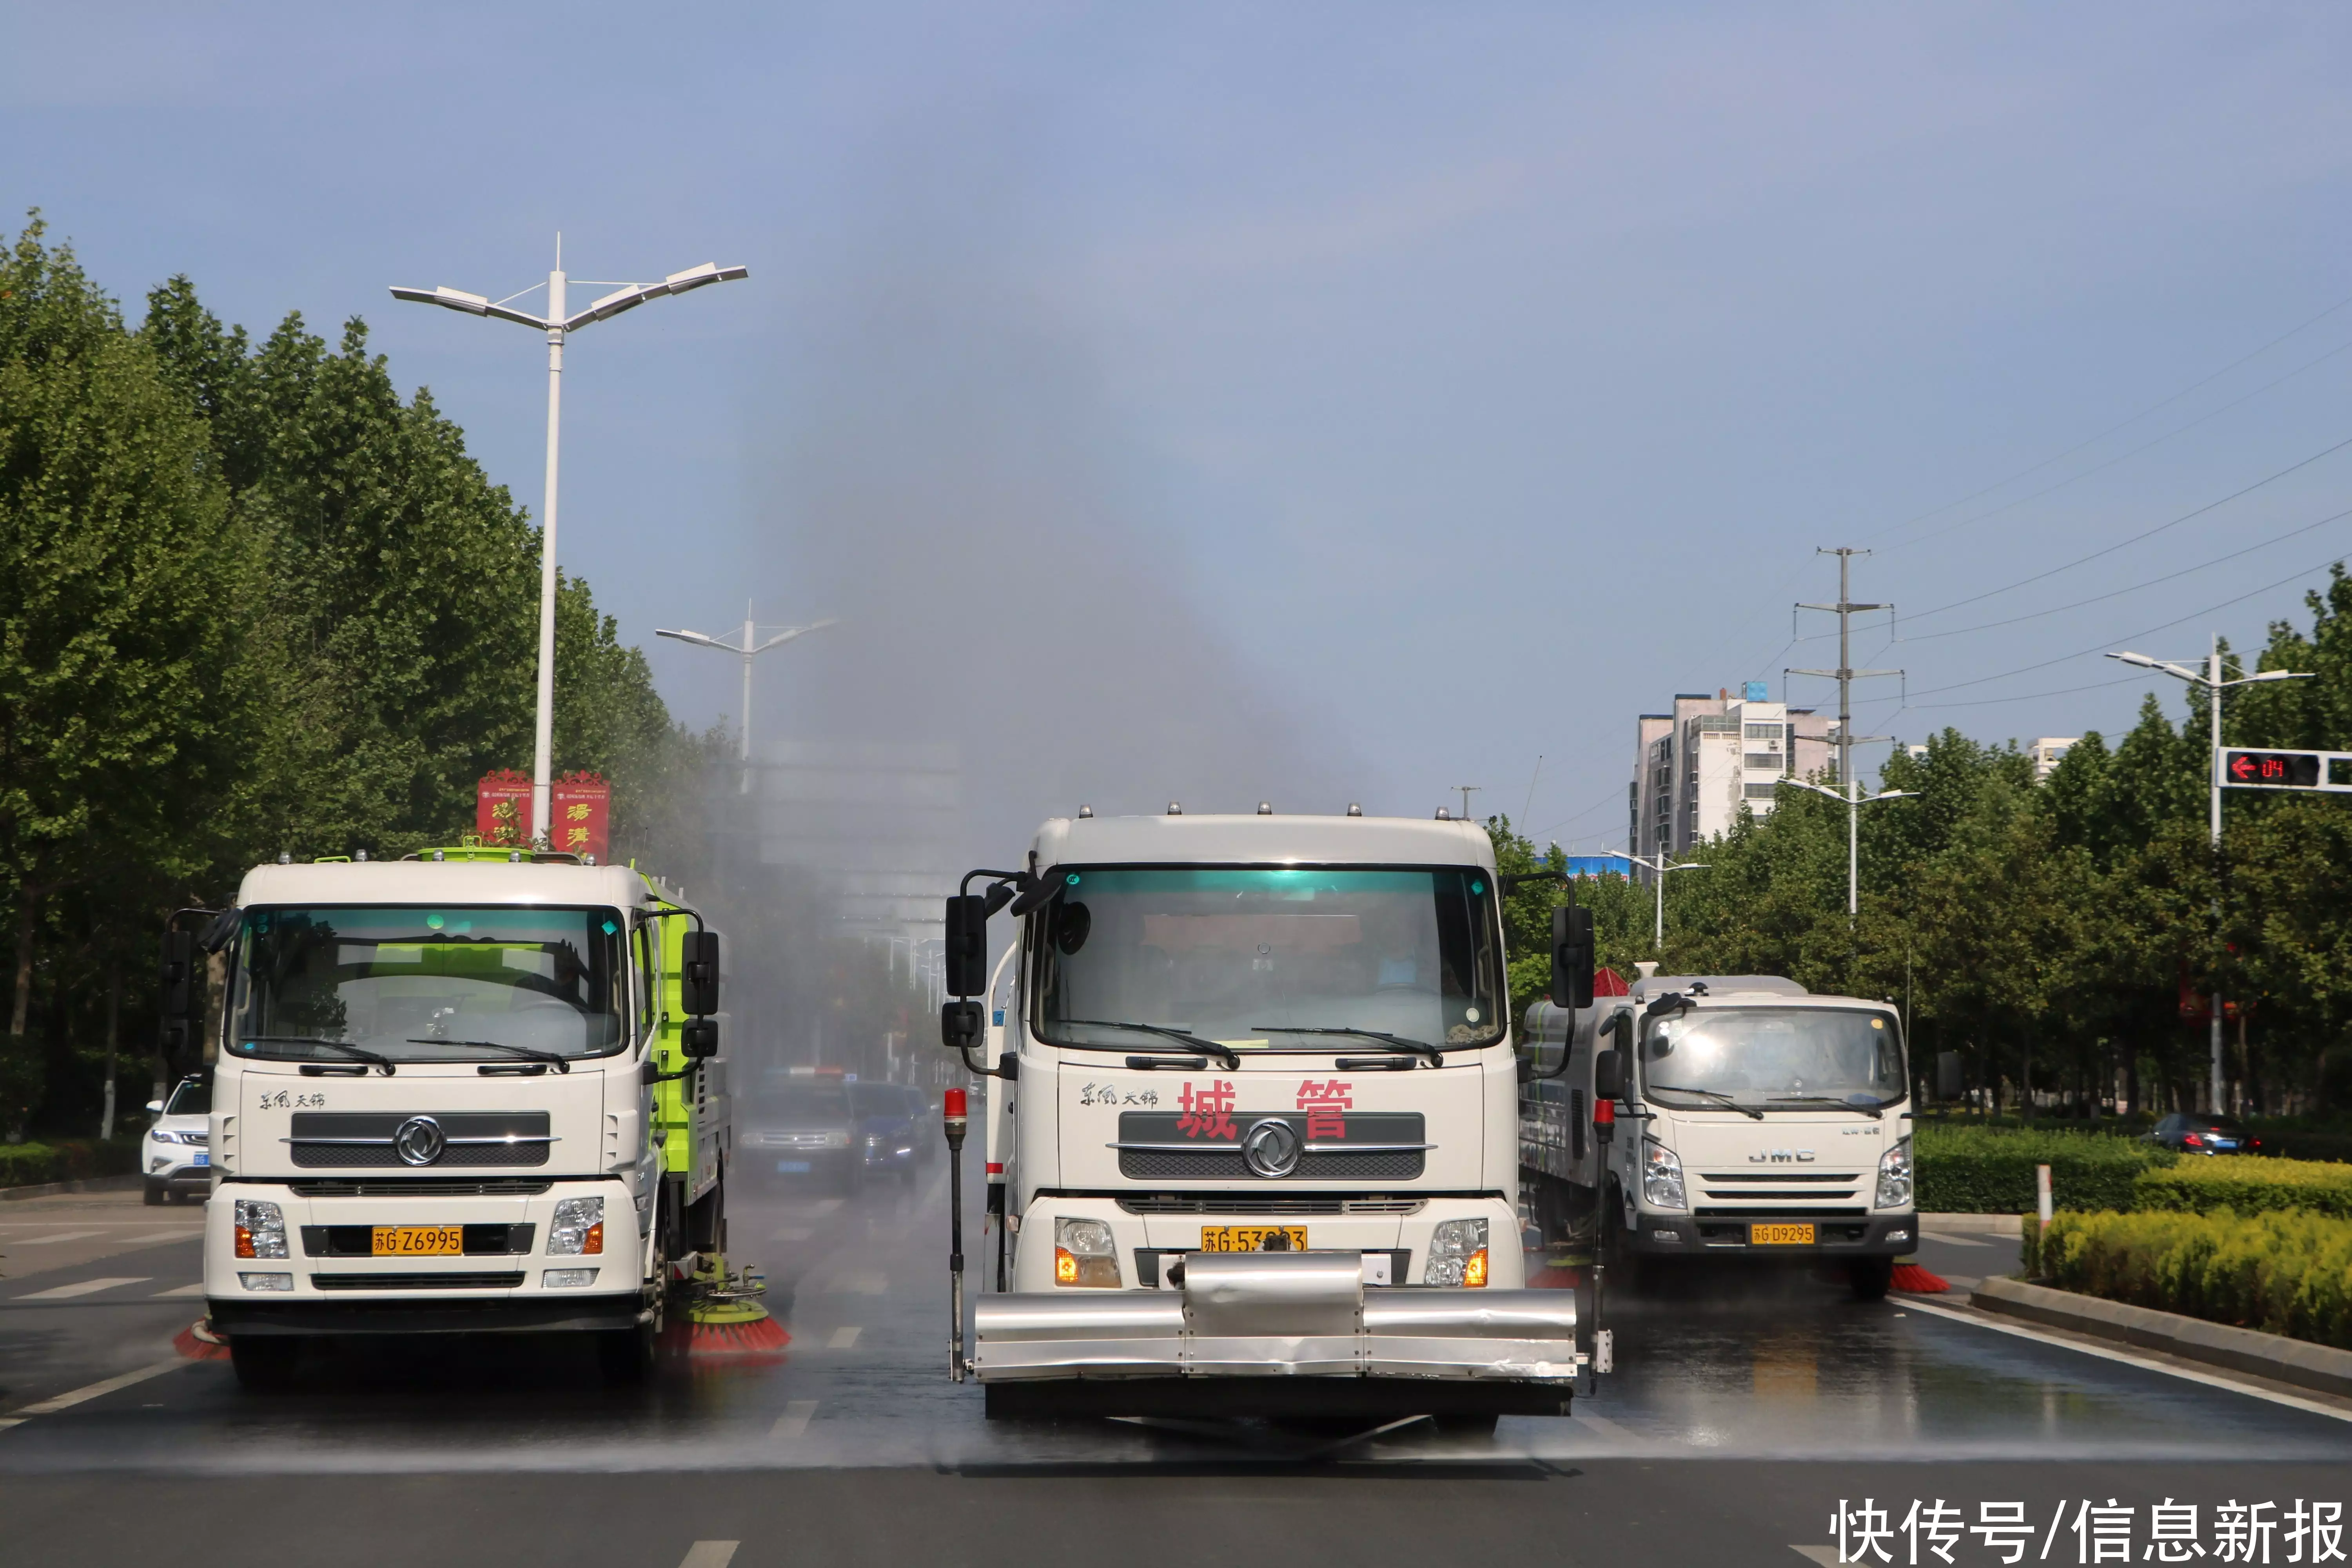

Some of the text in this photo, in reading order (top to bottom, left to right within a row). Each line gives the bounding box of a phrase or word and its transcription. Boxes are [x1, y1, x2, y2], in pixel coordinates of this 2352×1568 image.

[2262, 760, 2283, 777] 04
[566, 804, 592, 860] 湯溝
[1177, 1080, 1352, 1140] 城管
[1749, 1148, 1815, 1163] JMC
[1204, 1231, 1304, 1252] 苏G·533
